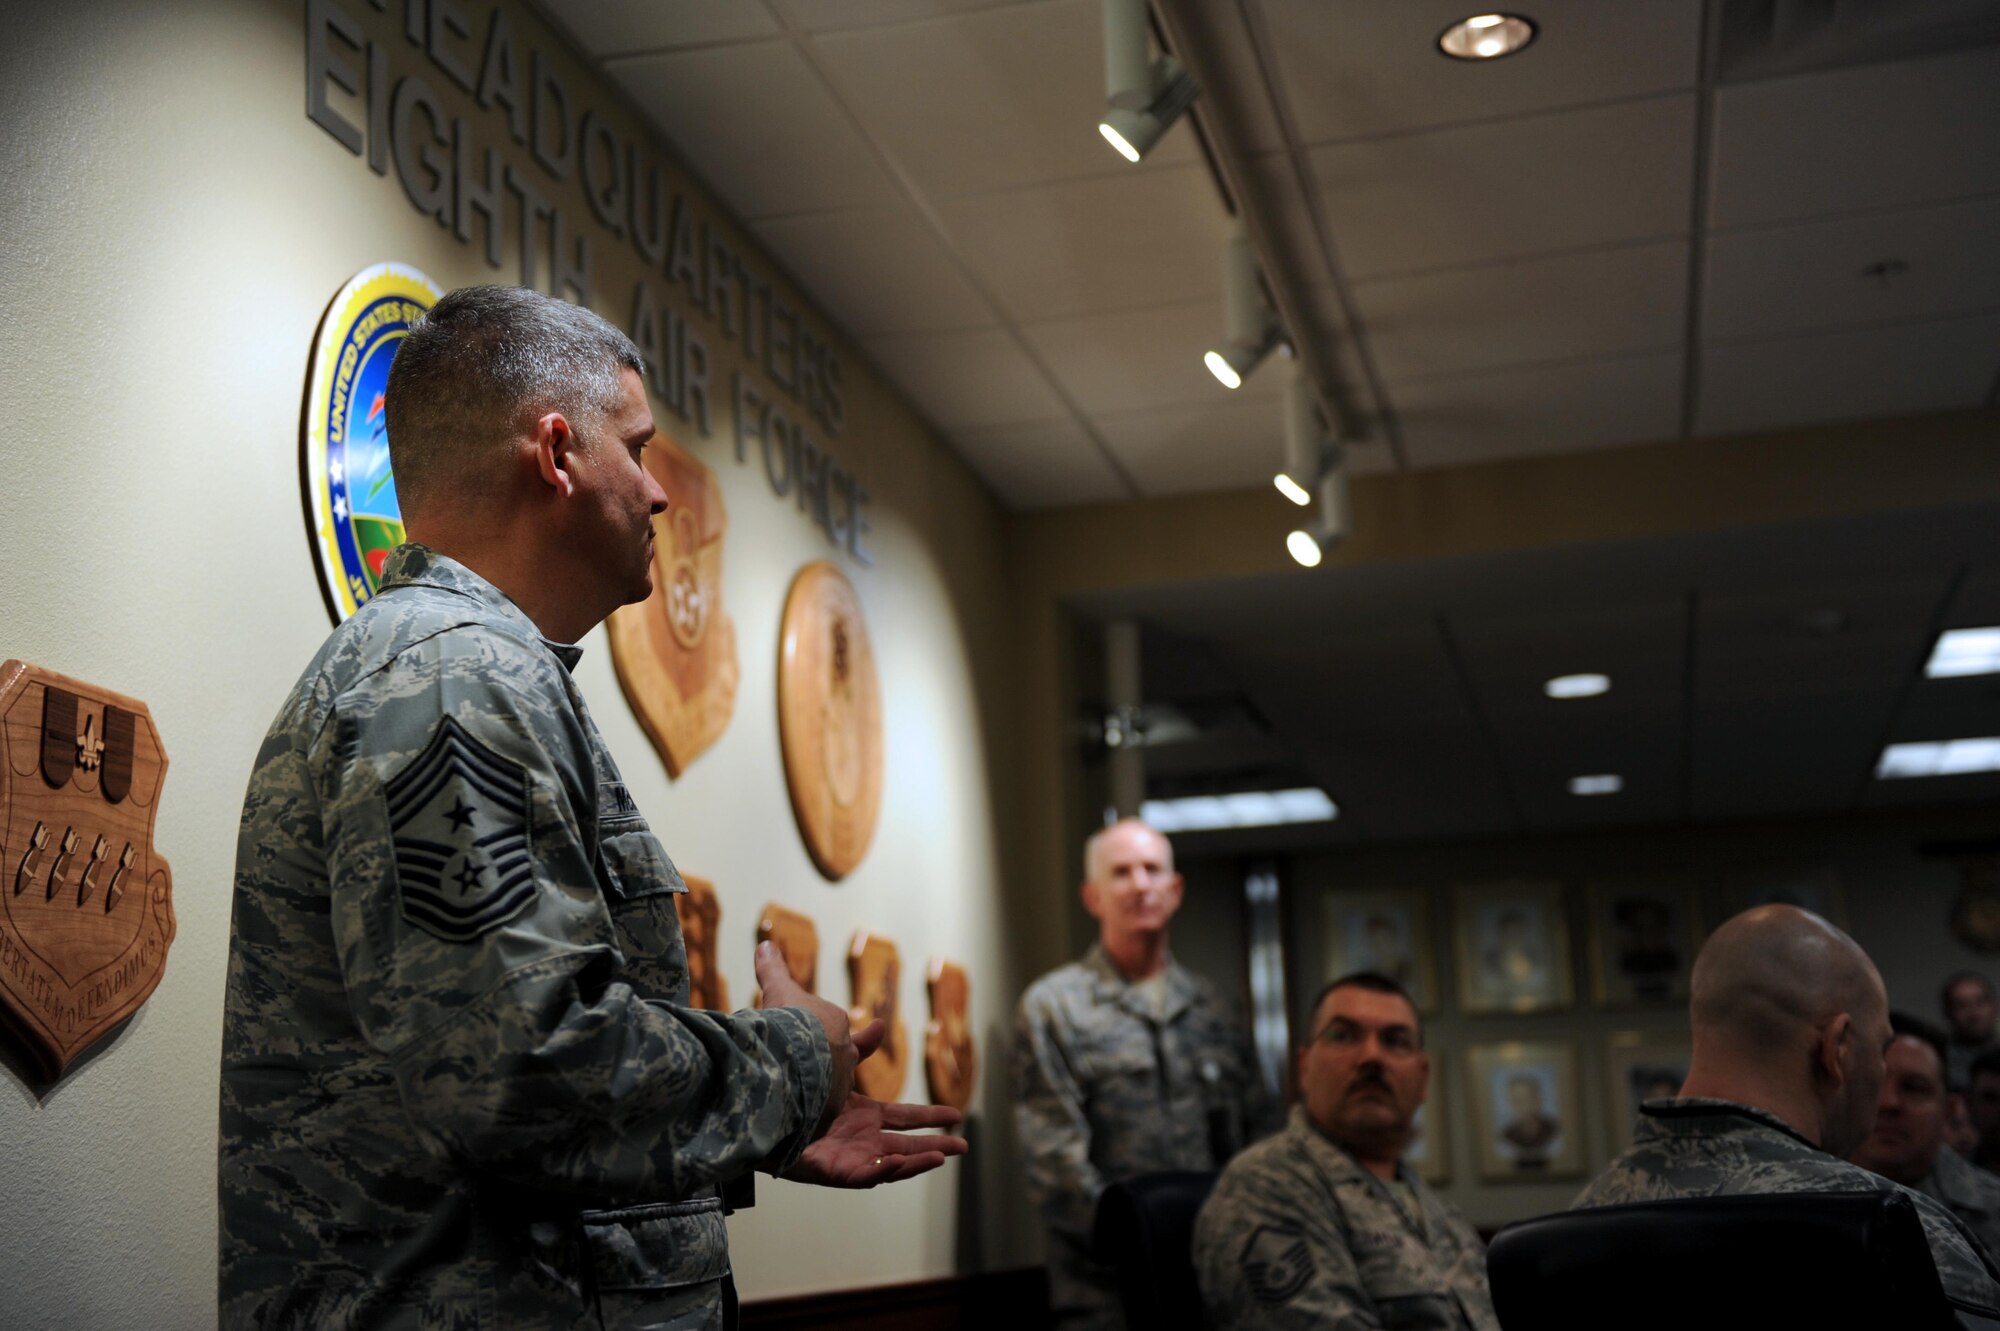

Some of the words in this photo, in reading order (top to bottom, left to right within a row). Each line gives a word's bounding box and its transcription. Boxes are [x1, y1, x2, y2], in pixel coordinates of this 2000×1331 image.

[368, 0, 845, 436] EADQUARTERS
[331, 343, 358, 443] UNITED
[353, 301, 402, 350] STATES
[632, 281, 715, 438] AIR
[731, 368, 876, 566] FORCE
[67, 931, 156, 1033] DEFENDIMUS
